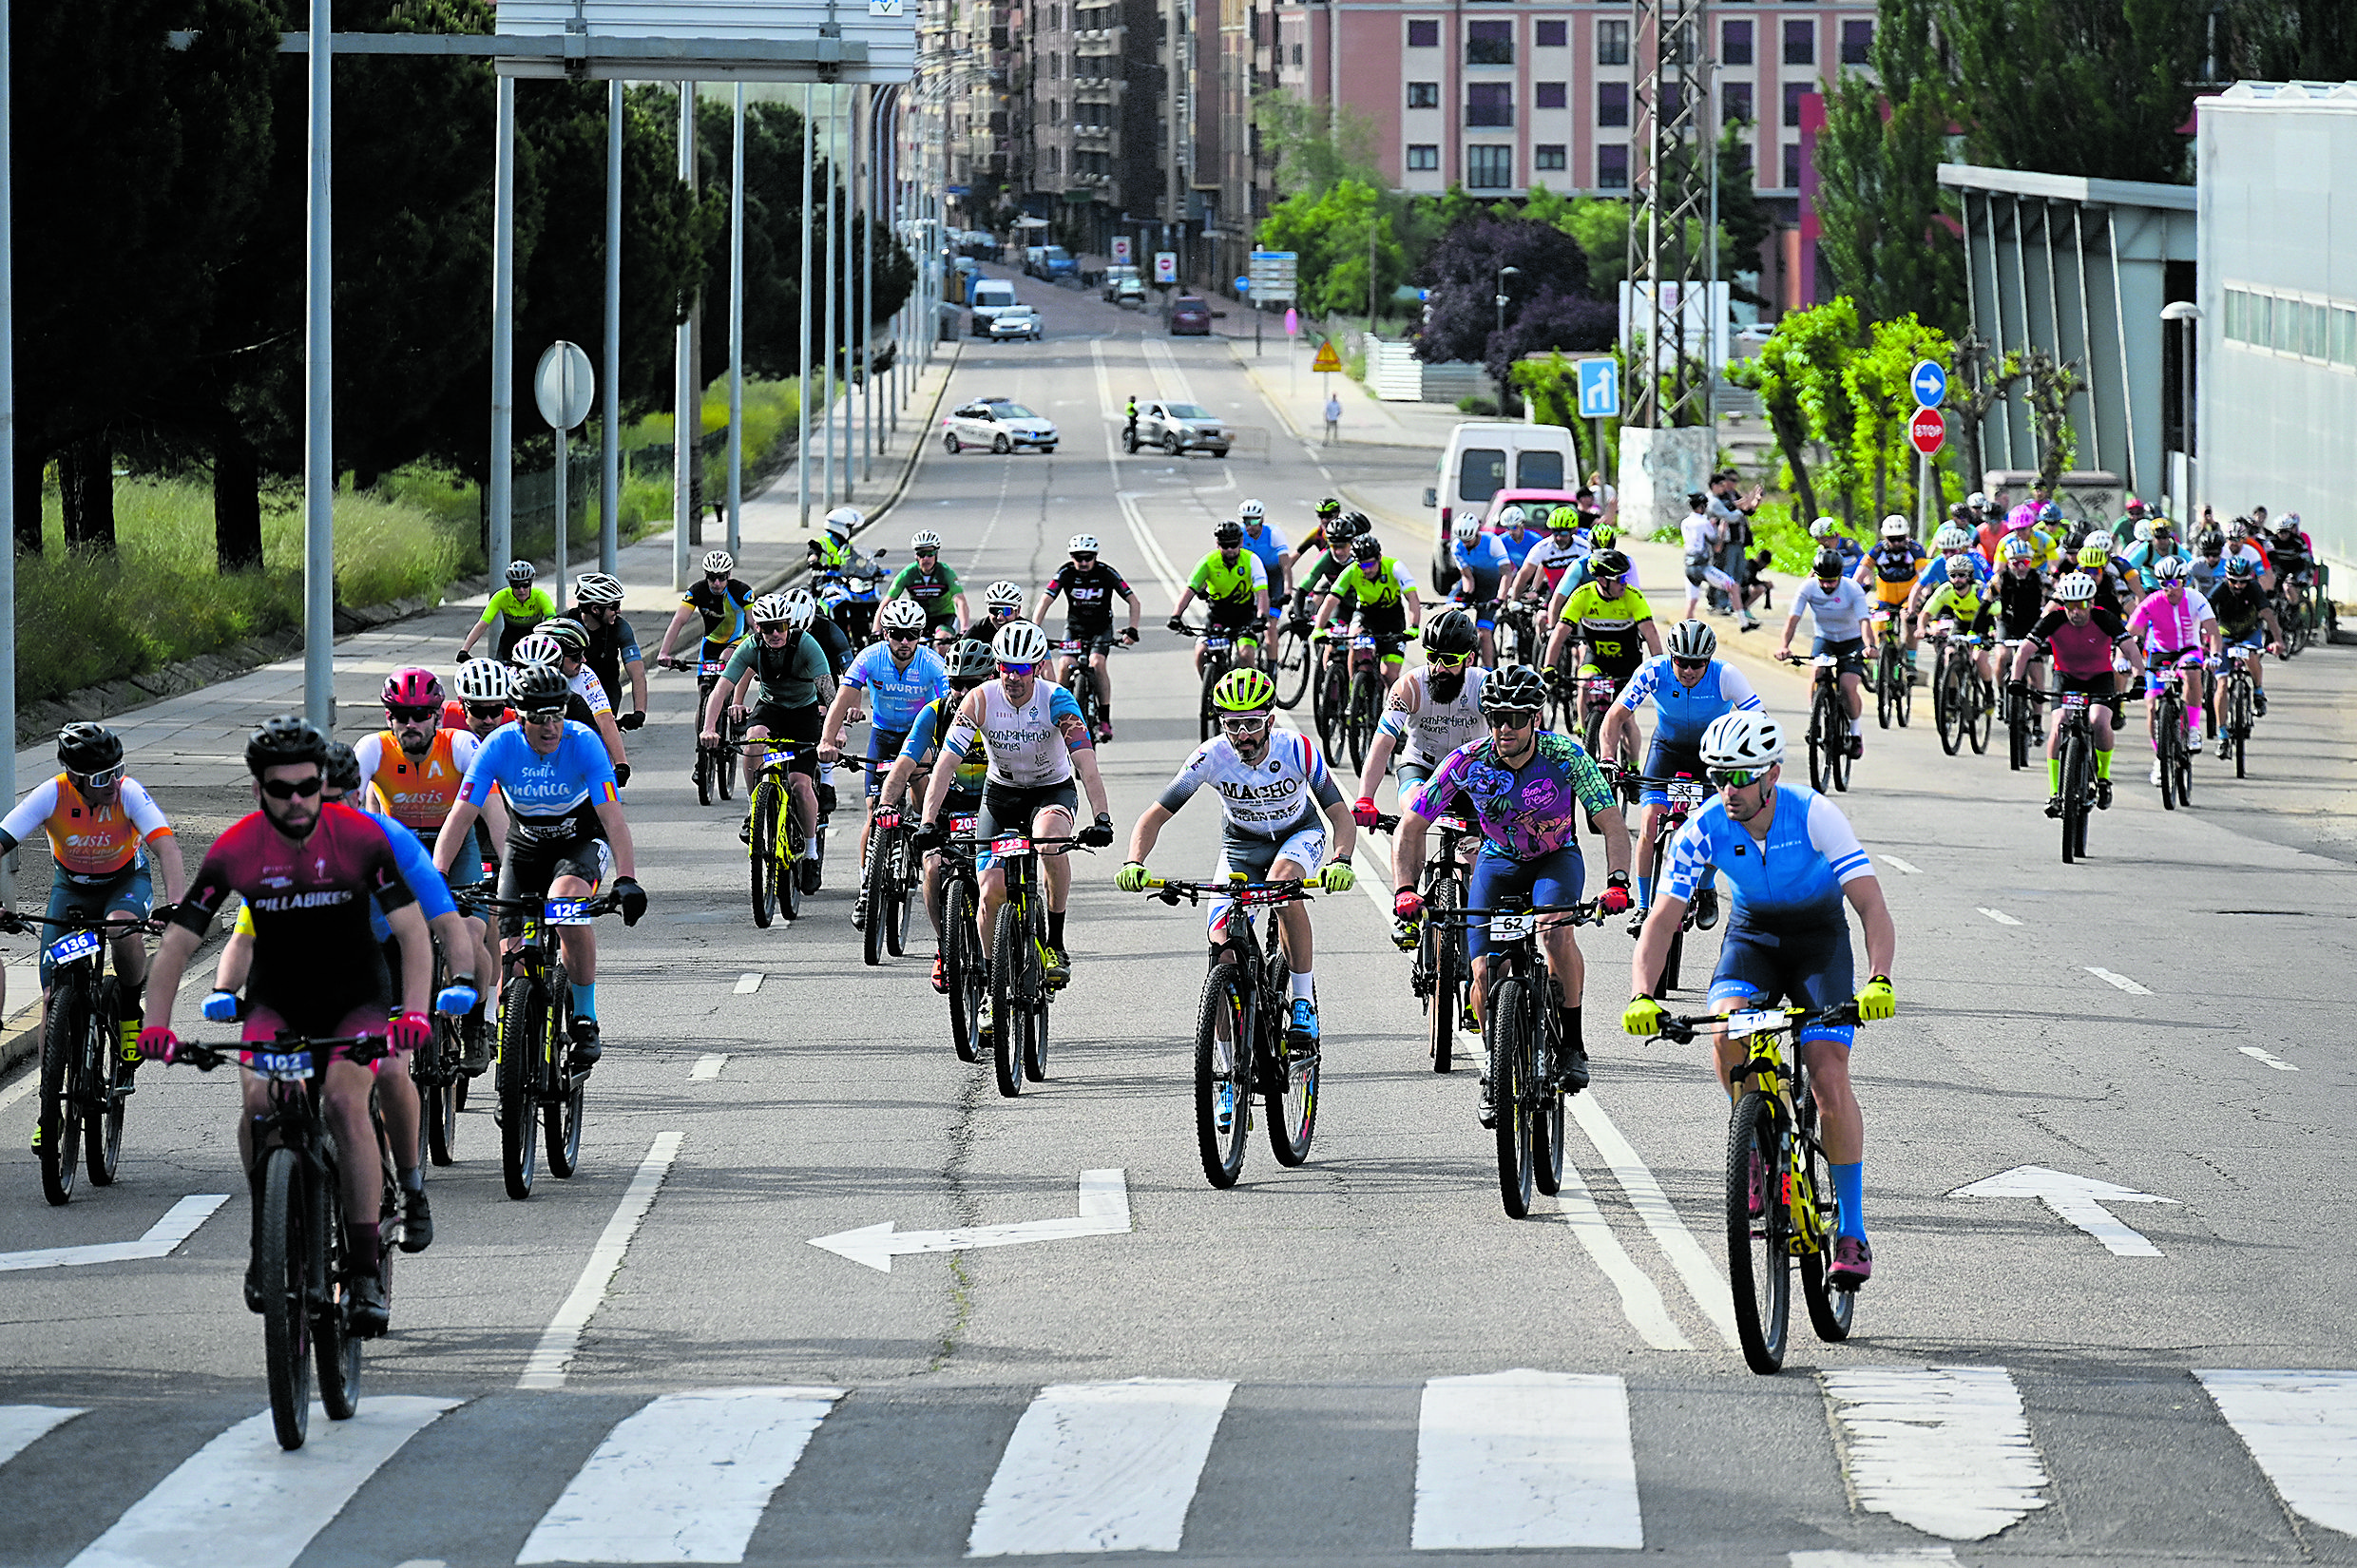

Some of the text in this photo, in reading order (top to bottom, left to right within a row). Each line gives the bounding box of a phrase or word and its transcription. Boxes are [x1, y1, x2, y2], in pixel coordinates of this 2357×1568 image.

[1915, 424, 1944, 437] STOP
[1070, 587, 1103, 600] BH
[886, 682, 928, 695] WÜRTH
[988, 729, 1051, 743] compartiendo
[1221, 777, 1297, 800] MACHO
[956, 818, 978, 831] 203
[997, 839, 1023, 851] 223
[255, 889, 353, 912] PILLABIKES
[552, 903, 582, 917] 126
[1504, 917, 1523, 930] 62
[59, 934, 89, 954] 136
[262, 1052, 303, 1070] 102
